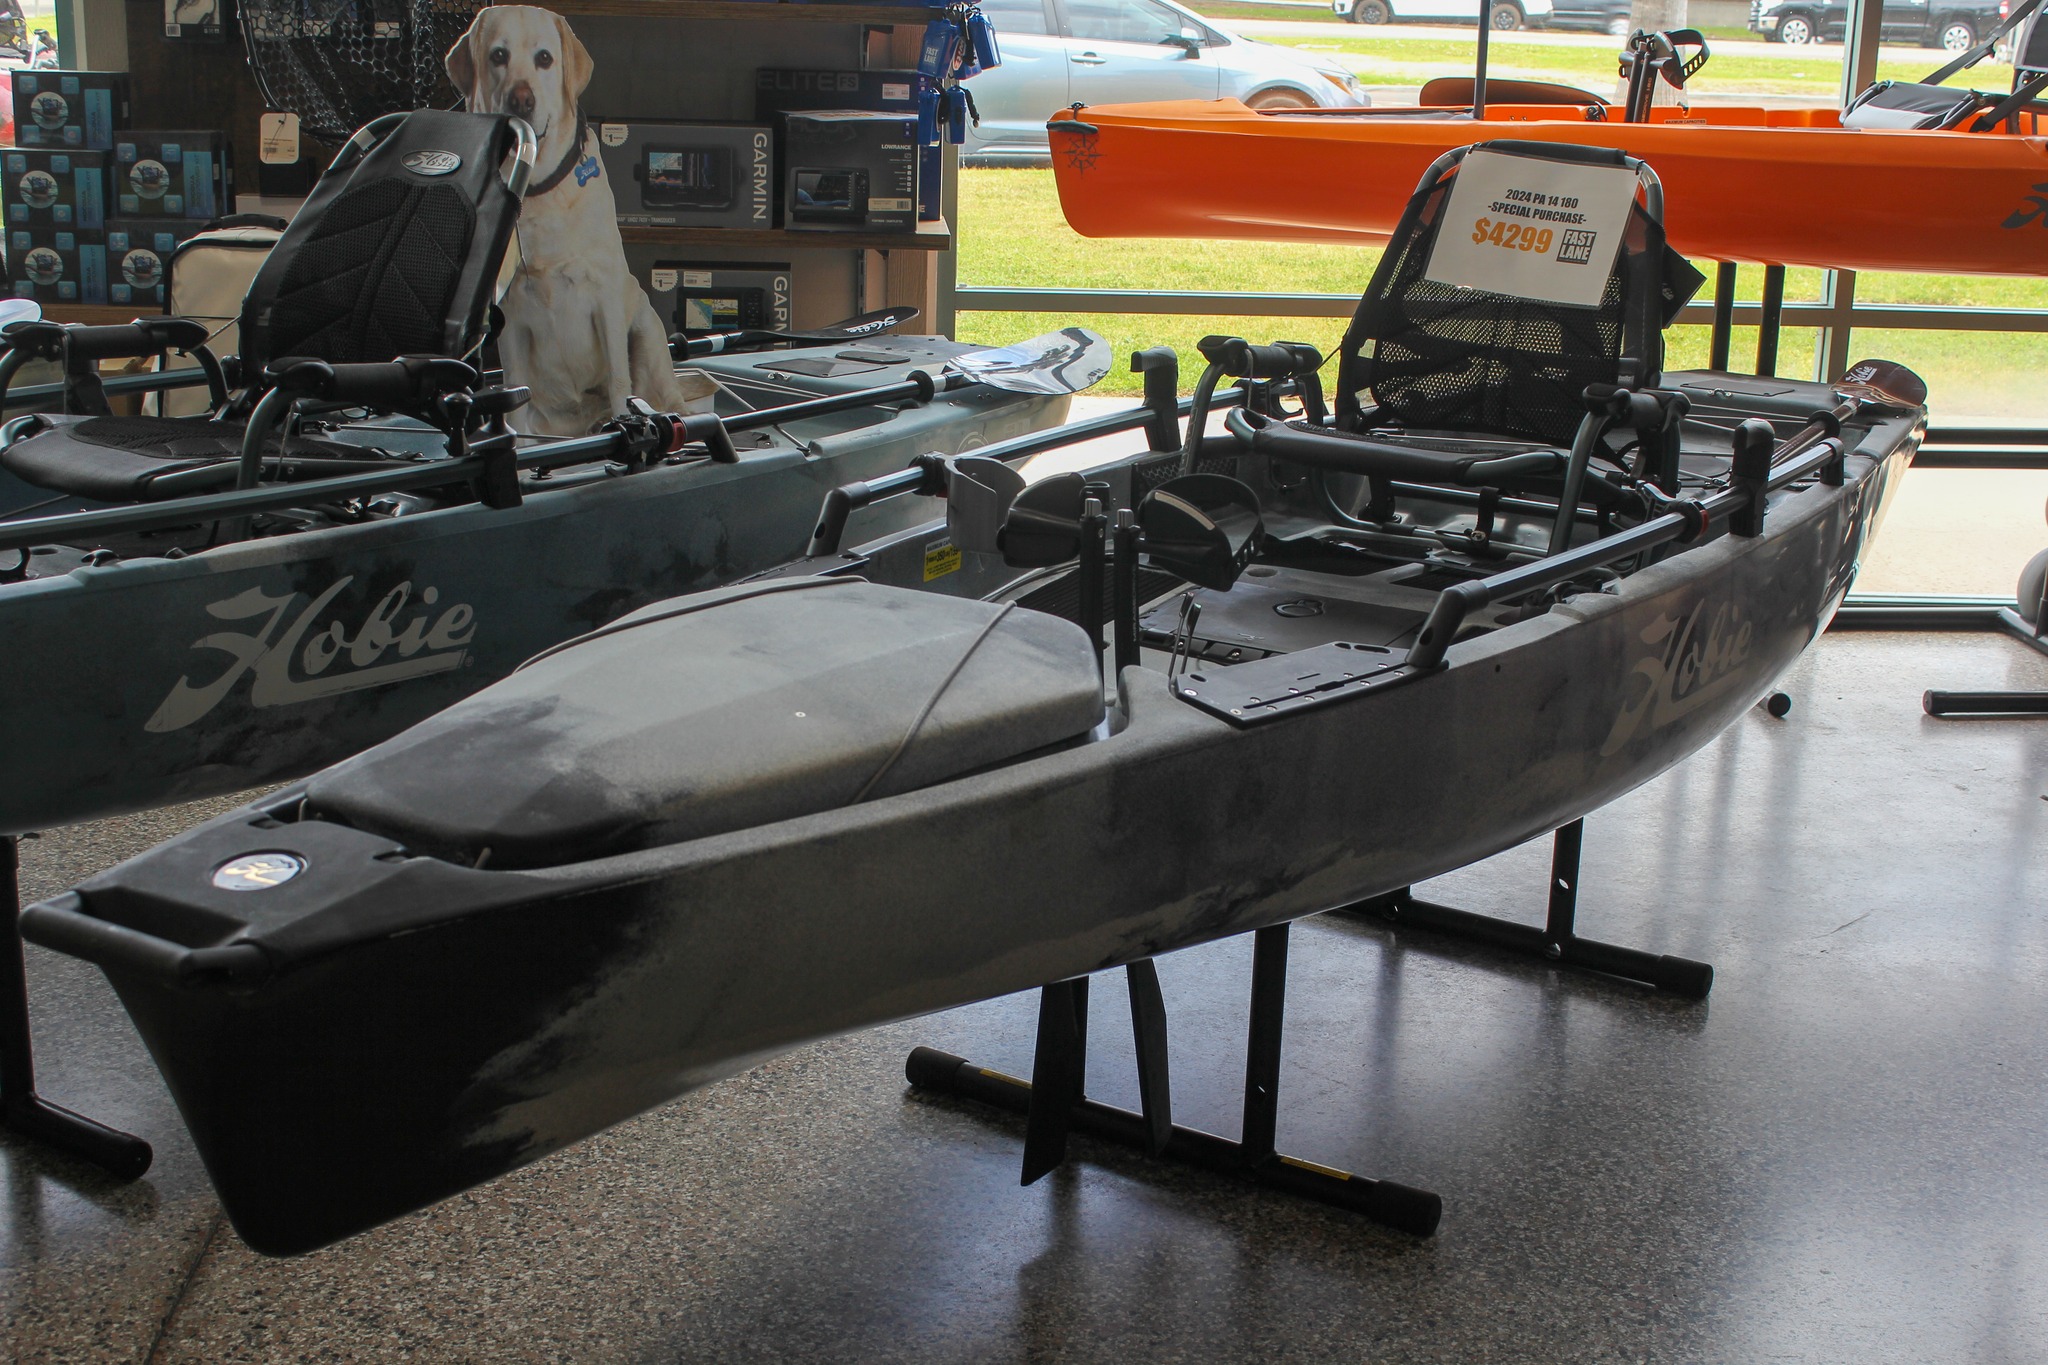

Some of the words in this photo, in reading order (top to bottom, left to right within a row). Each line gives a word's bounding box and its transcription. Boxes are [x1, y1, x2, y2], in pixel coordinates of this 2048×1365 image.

[924, 54, 937, 64] LANE
[925, 46, 939, 57] FAST
[757, 71, 834, 91] ELITE
[839, 75, 857, 89] FS
[753, 132, 769, 220] GARMIN
[1505, 188, 1532, 204] 2024
[1532, 193, 1546, 205] PA
[1547, 195, 1560, 207] 14
[1560, 197, 1579, 209] 180
[1487, 201, 1531, 218] -SPECIAL
[1532, 208, 1587, 225] PURCHASE-
[1471, 216, 1554, 254] $4299
[1563, 230, 1596, 247] FAST
[1559, 244, 1591, 261] LANE
[143, 574, 478, 733] Hobie
[1599, 597, 1755, 758] Hobie
